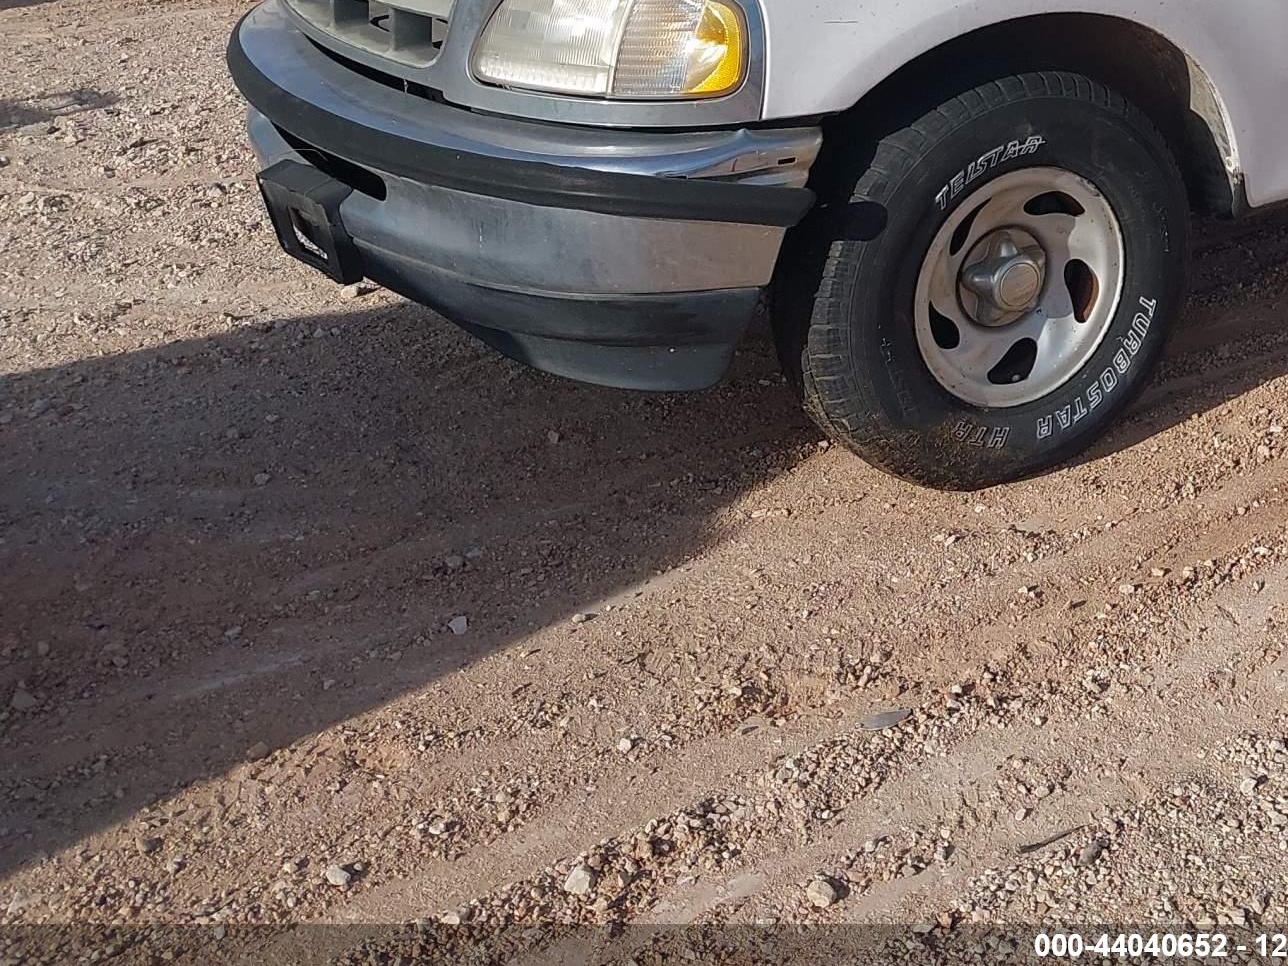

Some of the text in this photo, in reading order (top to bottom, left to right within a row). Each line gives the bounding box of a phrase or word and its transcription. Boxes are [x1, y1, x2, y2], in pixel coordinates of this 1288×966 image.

[935, 135, 1046, 211] TELSTAR
[951, 295, 1157, 449] TURBOSTAR HTR
